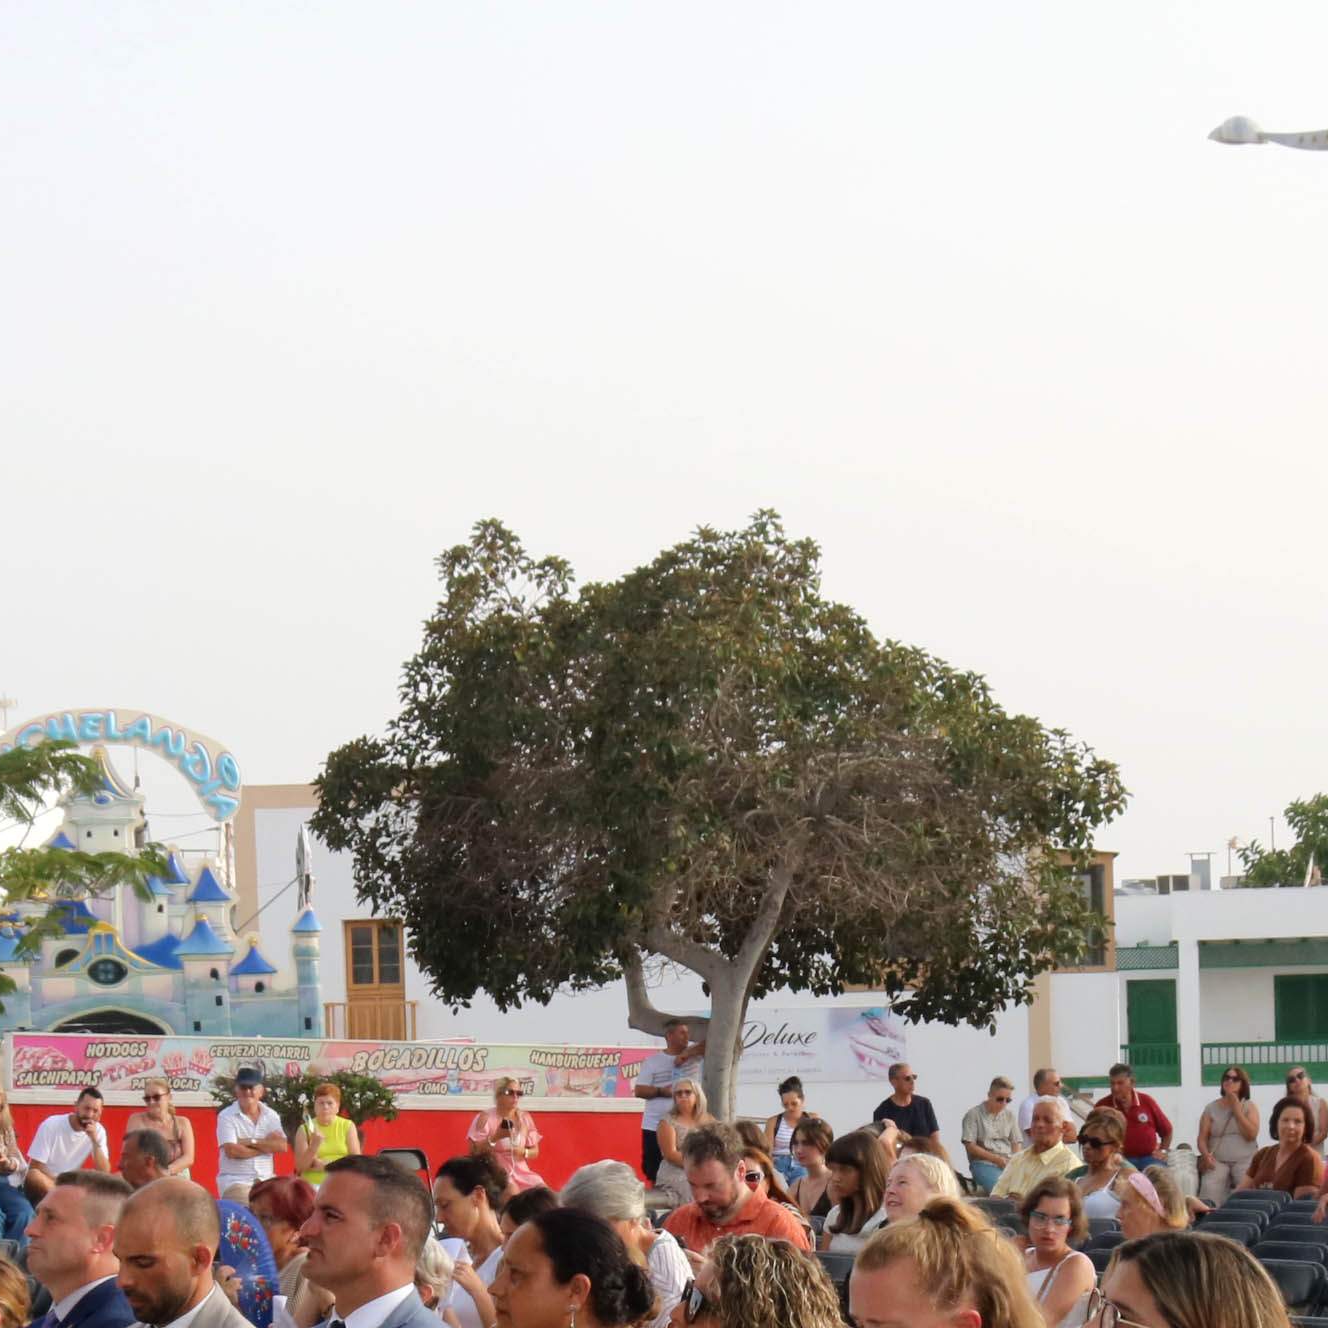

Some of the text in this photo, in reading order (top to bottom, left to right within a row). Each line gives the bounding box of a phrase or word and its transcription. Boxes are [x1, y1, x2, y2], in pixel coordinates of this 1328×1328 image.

[744, 1020, 818, 1050] Deluxe
[85, 1042, 147, 1058] HOTDOGS
[210, 1044, 311, 1060] CERVEZA DE BARRIL
[352, 1047, 488, 1073] BOCADILLOS
[529, 1050, 622, 1070] HAMBURGUESAS
[16, 1070, 102, 1087] SALCHIPAPAS
[167, 1078, 202, 1091] LOCAS
[417, 1081, 449, 1096] LOMO
